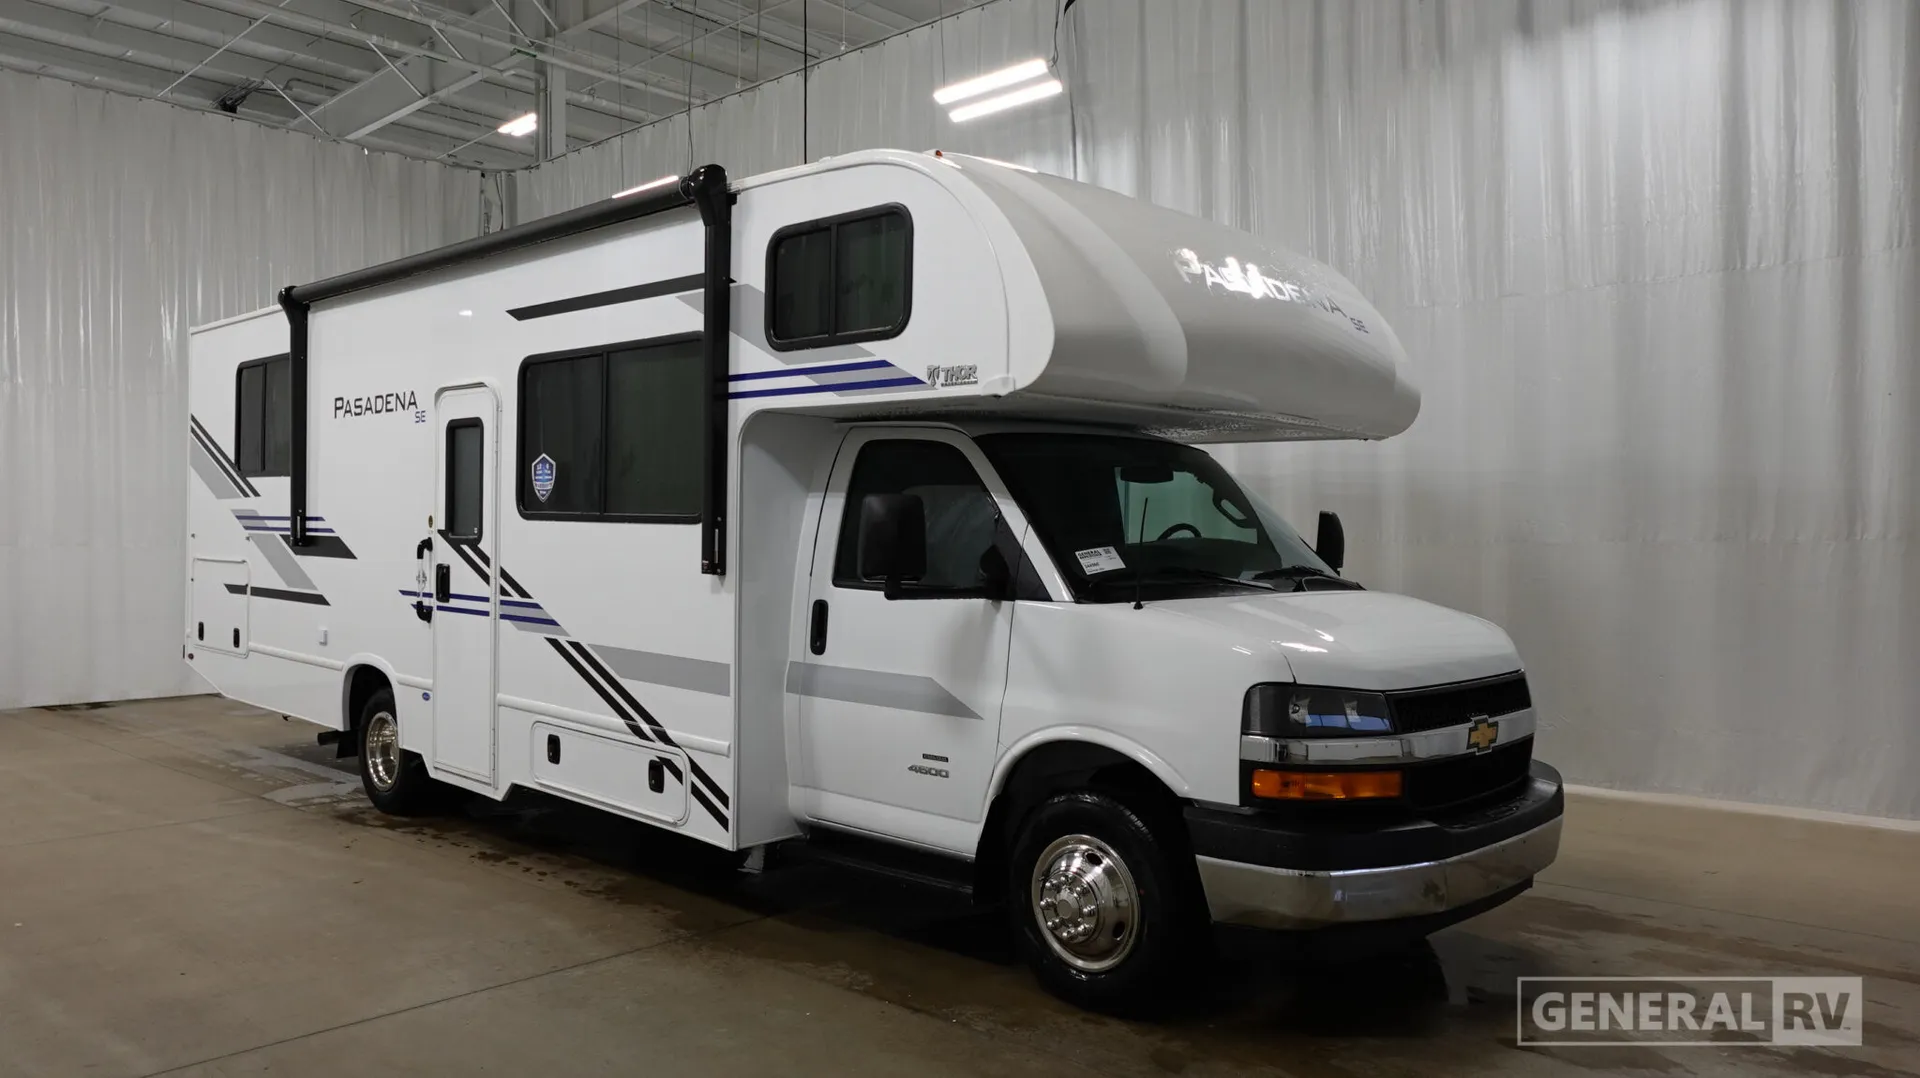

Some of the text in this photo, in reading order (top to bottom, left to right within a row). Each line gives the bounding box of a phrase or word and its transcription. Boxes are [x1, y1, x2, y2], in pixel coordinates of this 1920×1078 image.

[941, 364, 978, 382] THOR
[334, 390, 418, 419] PASADENA
[414, 410, 426, 423] SE
